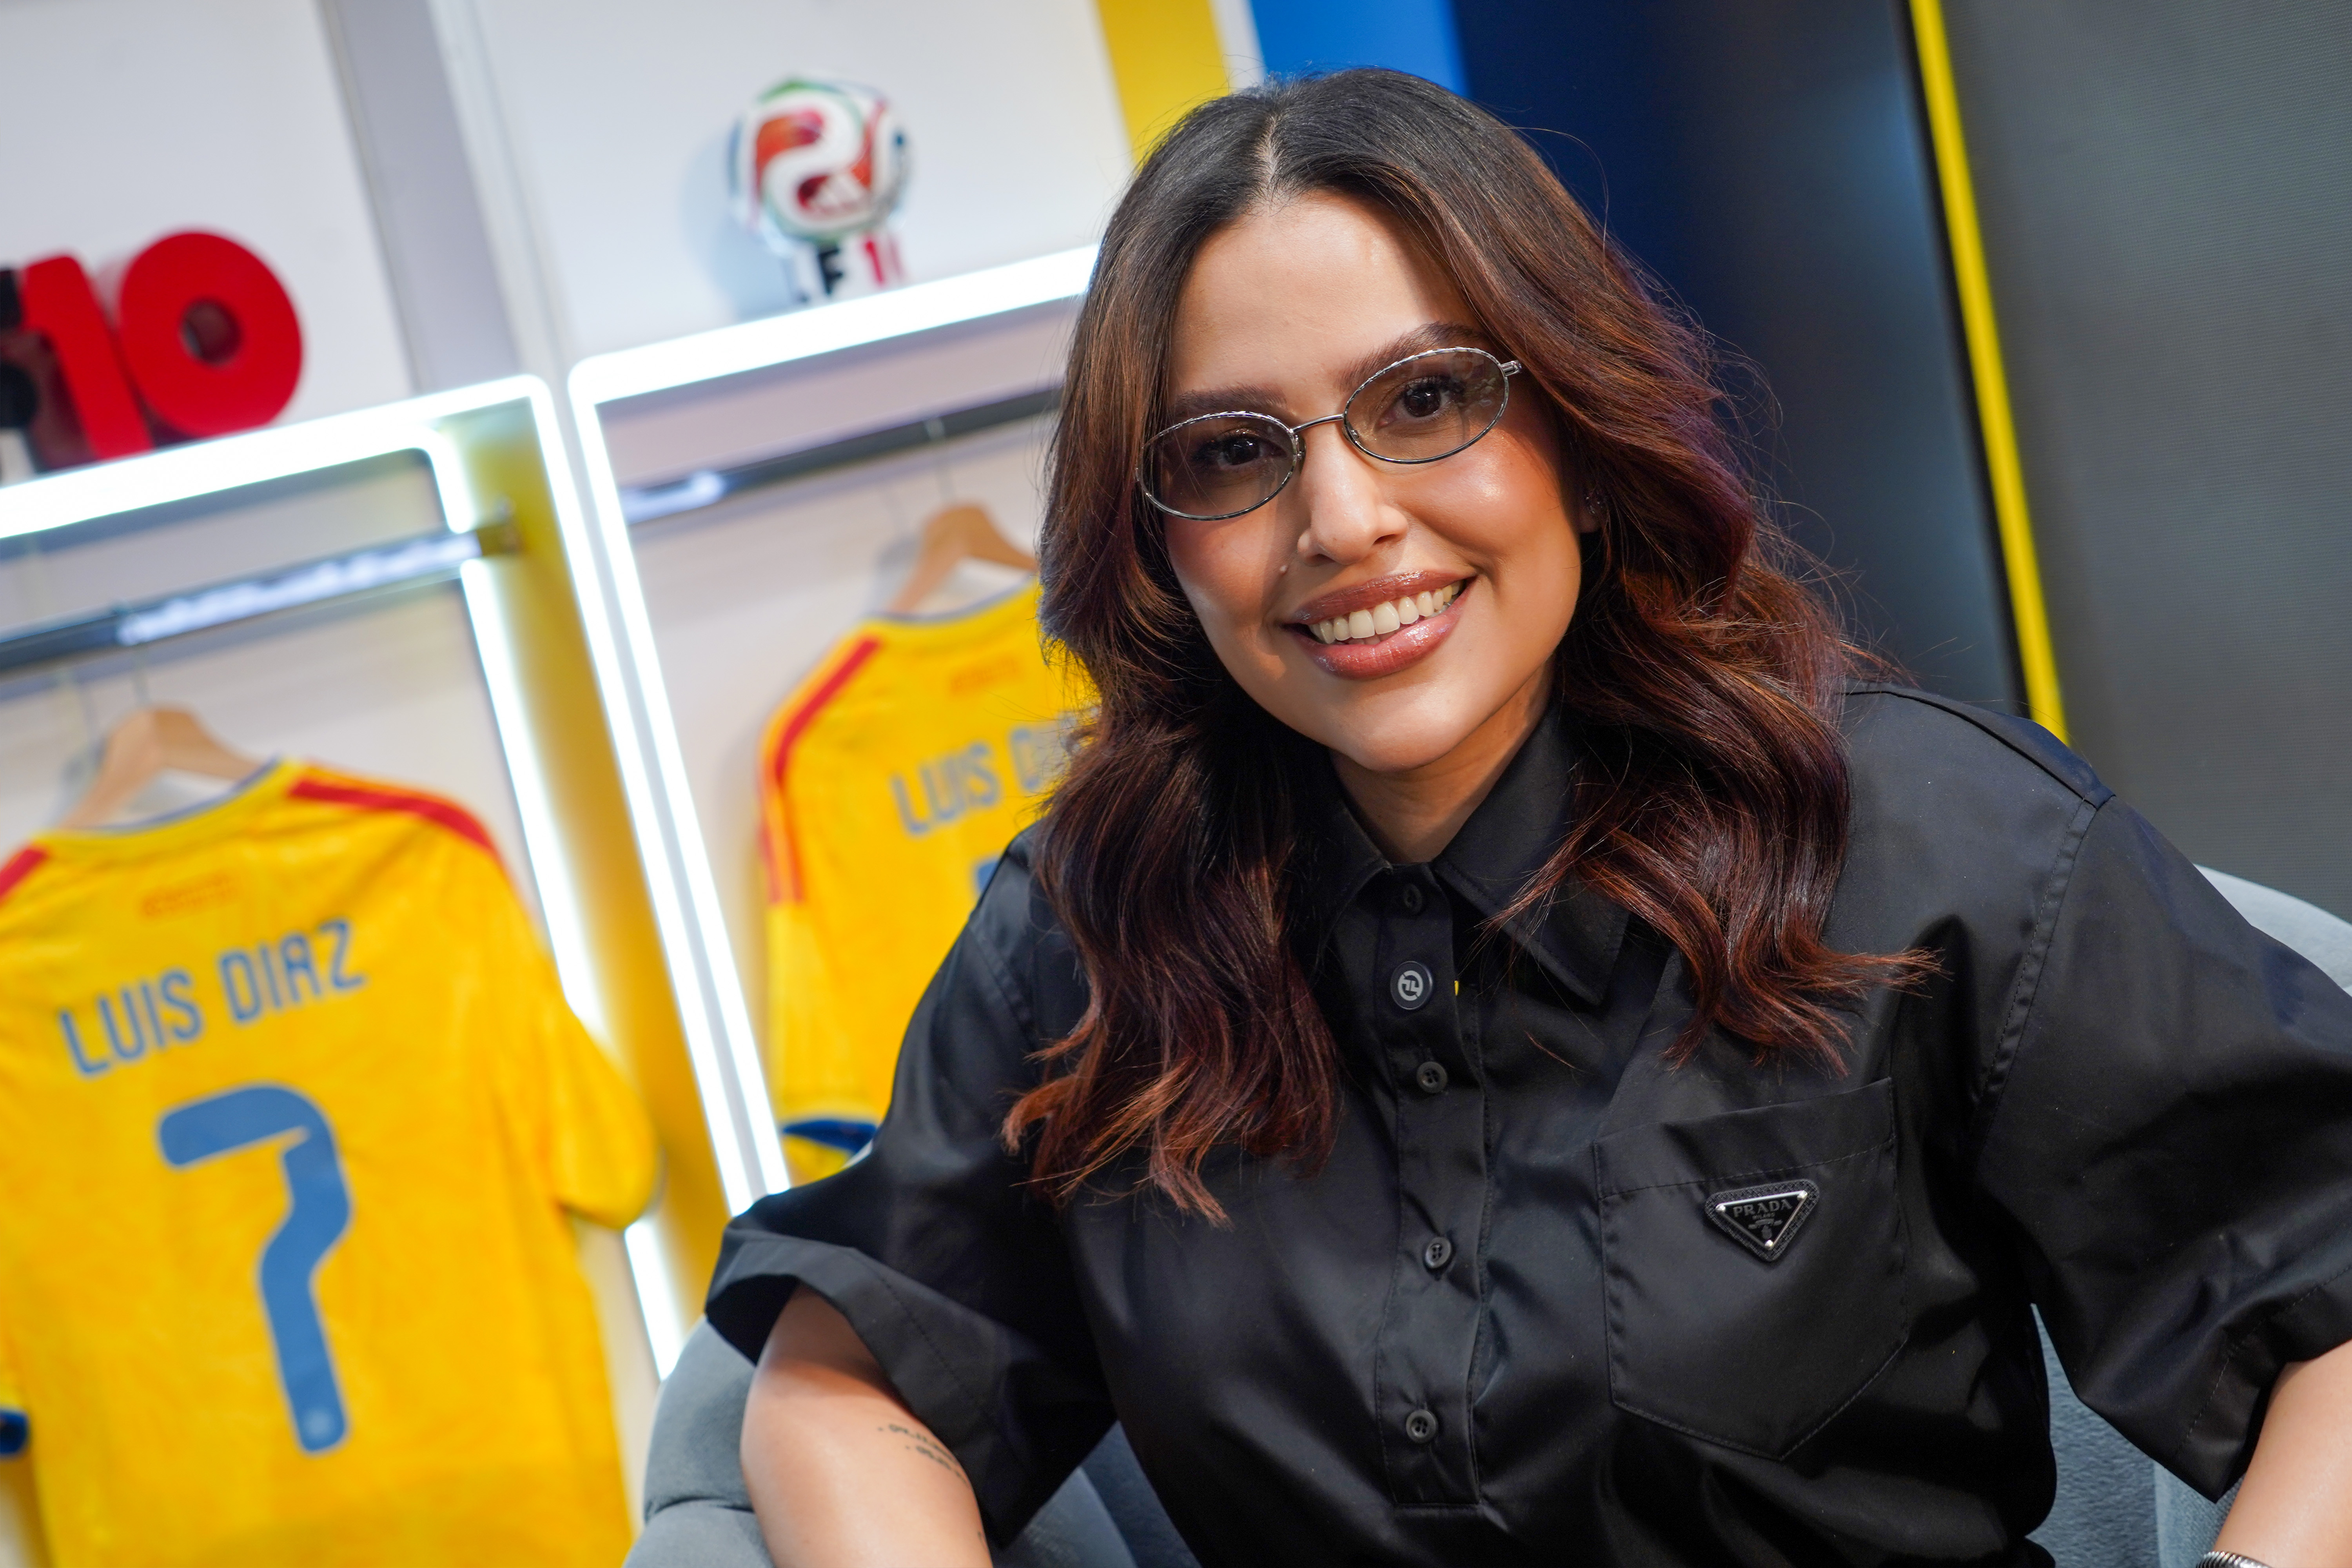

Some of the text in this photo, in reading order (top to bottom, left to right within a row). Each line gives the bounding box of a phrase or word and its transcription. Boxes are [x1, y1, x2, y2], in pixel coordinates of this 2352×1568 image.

[890, 739, 1001, 839] LUIS
[57, 917, 368, 1076] LUIS DIAZ
[157, 1082, 351, 1456] 7
[1733, 1199, 1793, 1217] PRADA
